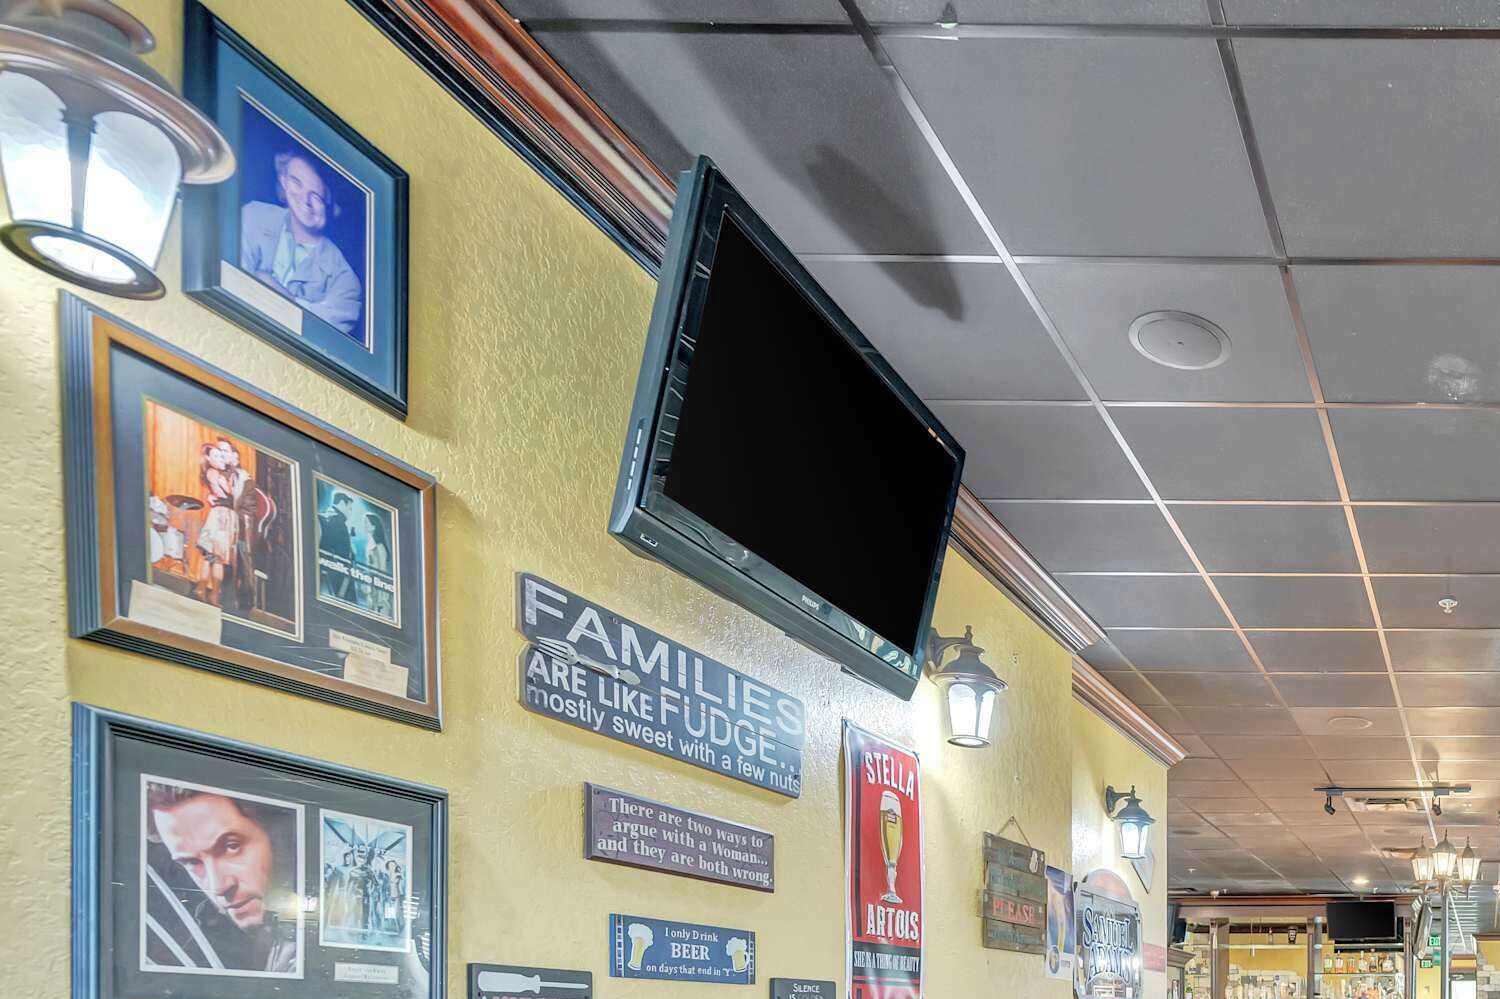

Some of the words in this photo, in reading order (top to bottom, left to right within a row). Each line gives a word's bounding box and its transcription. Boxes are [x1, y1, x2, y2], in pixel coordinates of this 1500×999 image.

[320, 557, 349, 576] walk
[351, 569, 373, 584] the
[801, 594, 820, 610] PHILIPS
[524, 577, 801, 736] FAMILIES
[526, 651, 588, 698] ARE
[598, 675, 654, 722] LIKE
[659, 686, 801, 774] FUDGE...
[526, 683, 605, 732] mostly
[612, 714, 674, 751] sweet
[678, 737, 716, 766] with
[721, 753, 732, 771] a
[736, 755, 765, 784] few
[769, 771, 801, 794] nuts
[863, 751, 915, 801] STELLA
[608, 797, 655, 820] There
[658, 809, 683, 828] are
[687, 816, 713, 837] two
[716, 828, 748, 849] ways
[751, 833, 764, 849] to
[612, 819, 658, 840] argue
[662, 828, 695, 849] with
[698, 840, 707, 852] a
[711, 841, 769, 866] Woman...
[597, 836, 628, 853] and
[633, 840, 667, 864] they
[671, 850, 695, 867] are
[698, 855, 730, 877] both
[732, 866, 774, 888] wrong.
[665, 927, 670, 938] I
[671, 929, 690, 941] only
[692, 930, 719, 943] Drink
[865, 902, 920, 941] ARTOIS
[1082, 905, 1134, 950] SAMUEL
[646, 964, 657, 973] on
[658, 963, 678, 975] days
[679, 965, 696, 976] that
[697, 966, 712, 976] end
[713, 967, 721, 976] in
[670, 942, 711, 961] BEER
[853, 950, 865, 968] SHE
